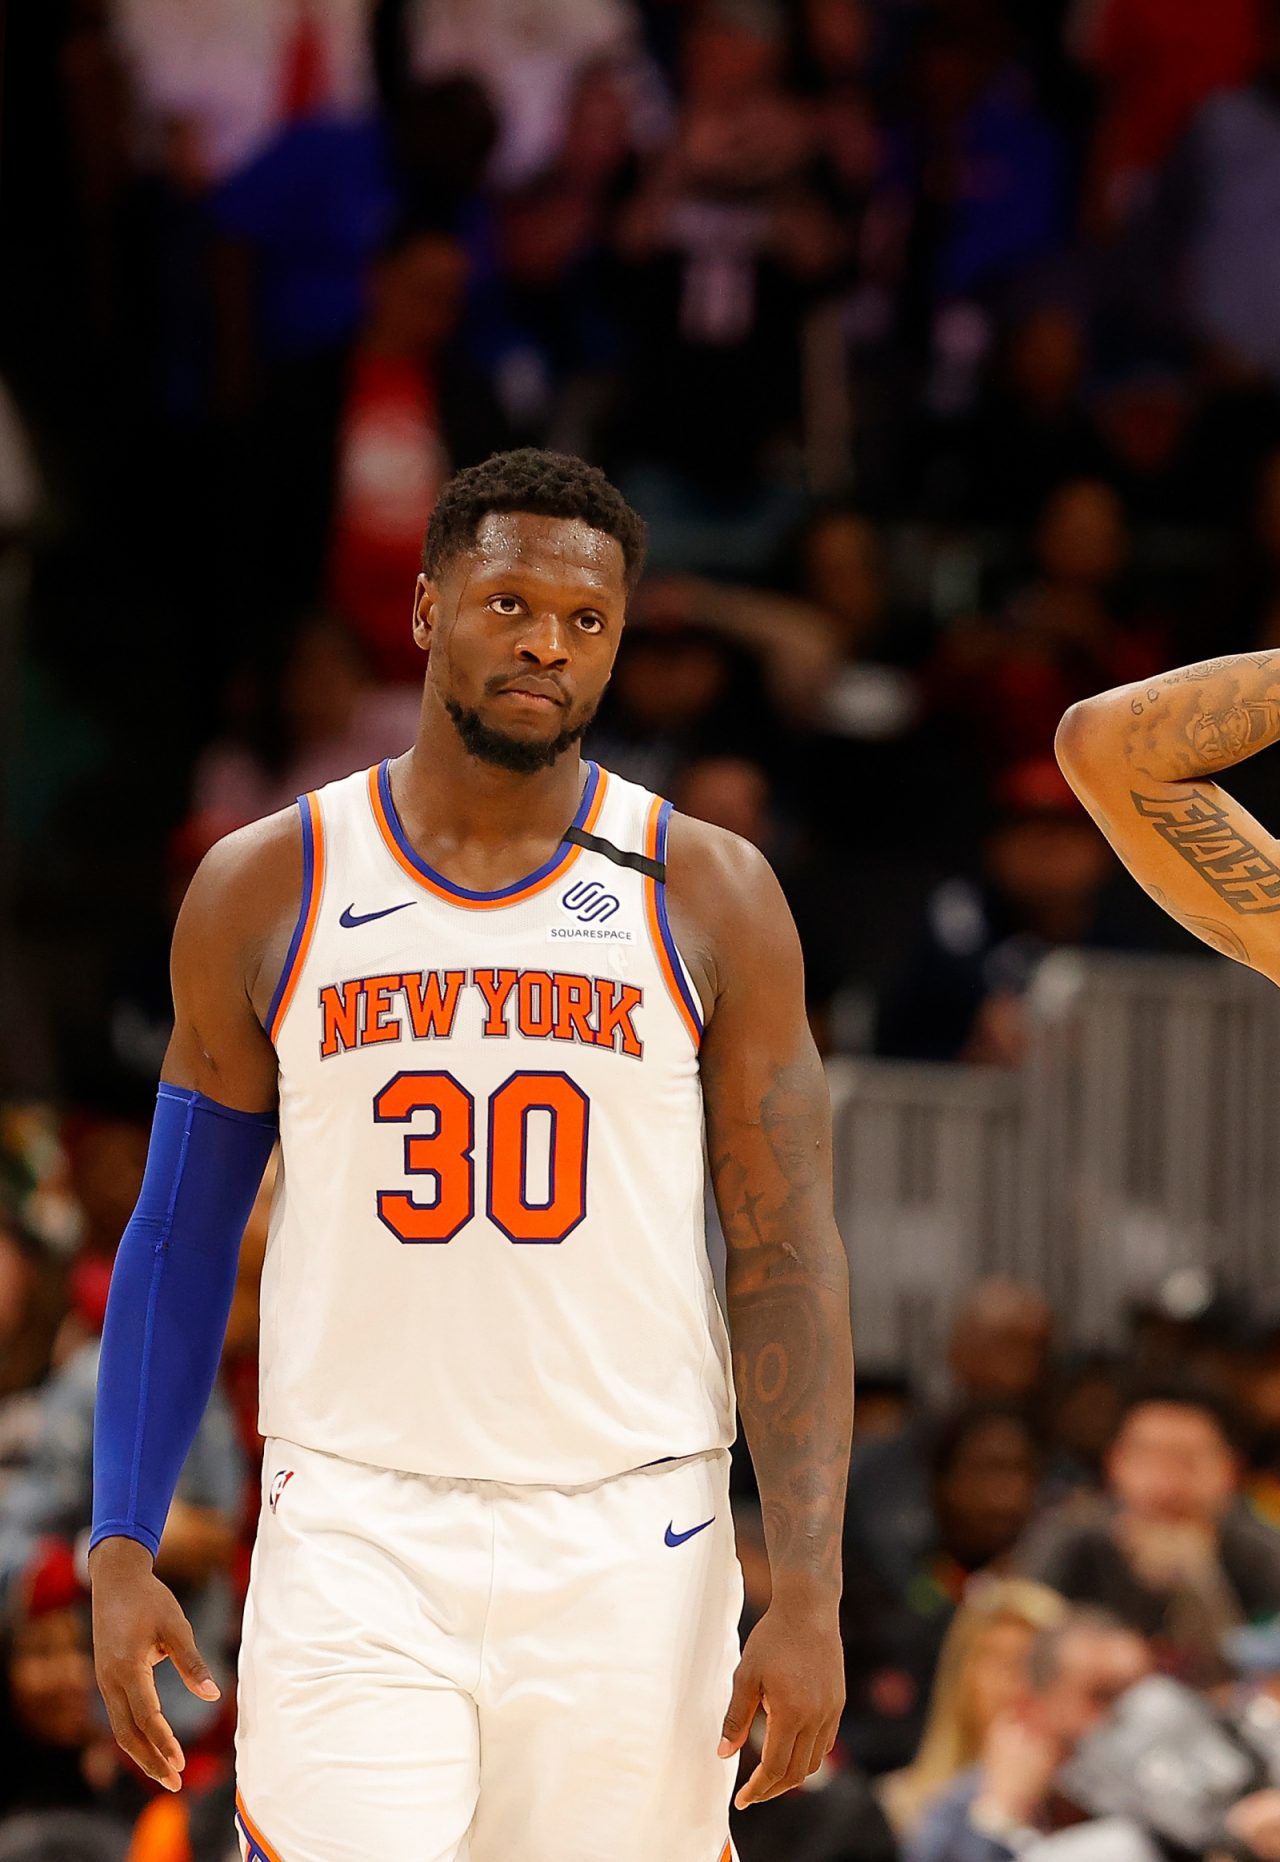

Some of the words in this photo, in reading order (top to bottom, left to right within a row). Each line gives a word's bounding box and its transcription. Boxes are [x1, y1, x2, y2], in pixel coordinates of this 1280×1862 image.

[551, 928, 632, 941] SQUARESPACE
[318, 969, 466, 1061] NEW
[470, 968, 644, 1061] YORK
[373, 1070, 590, 1244] 30
